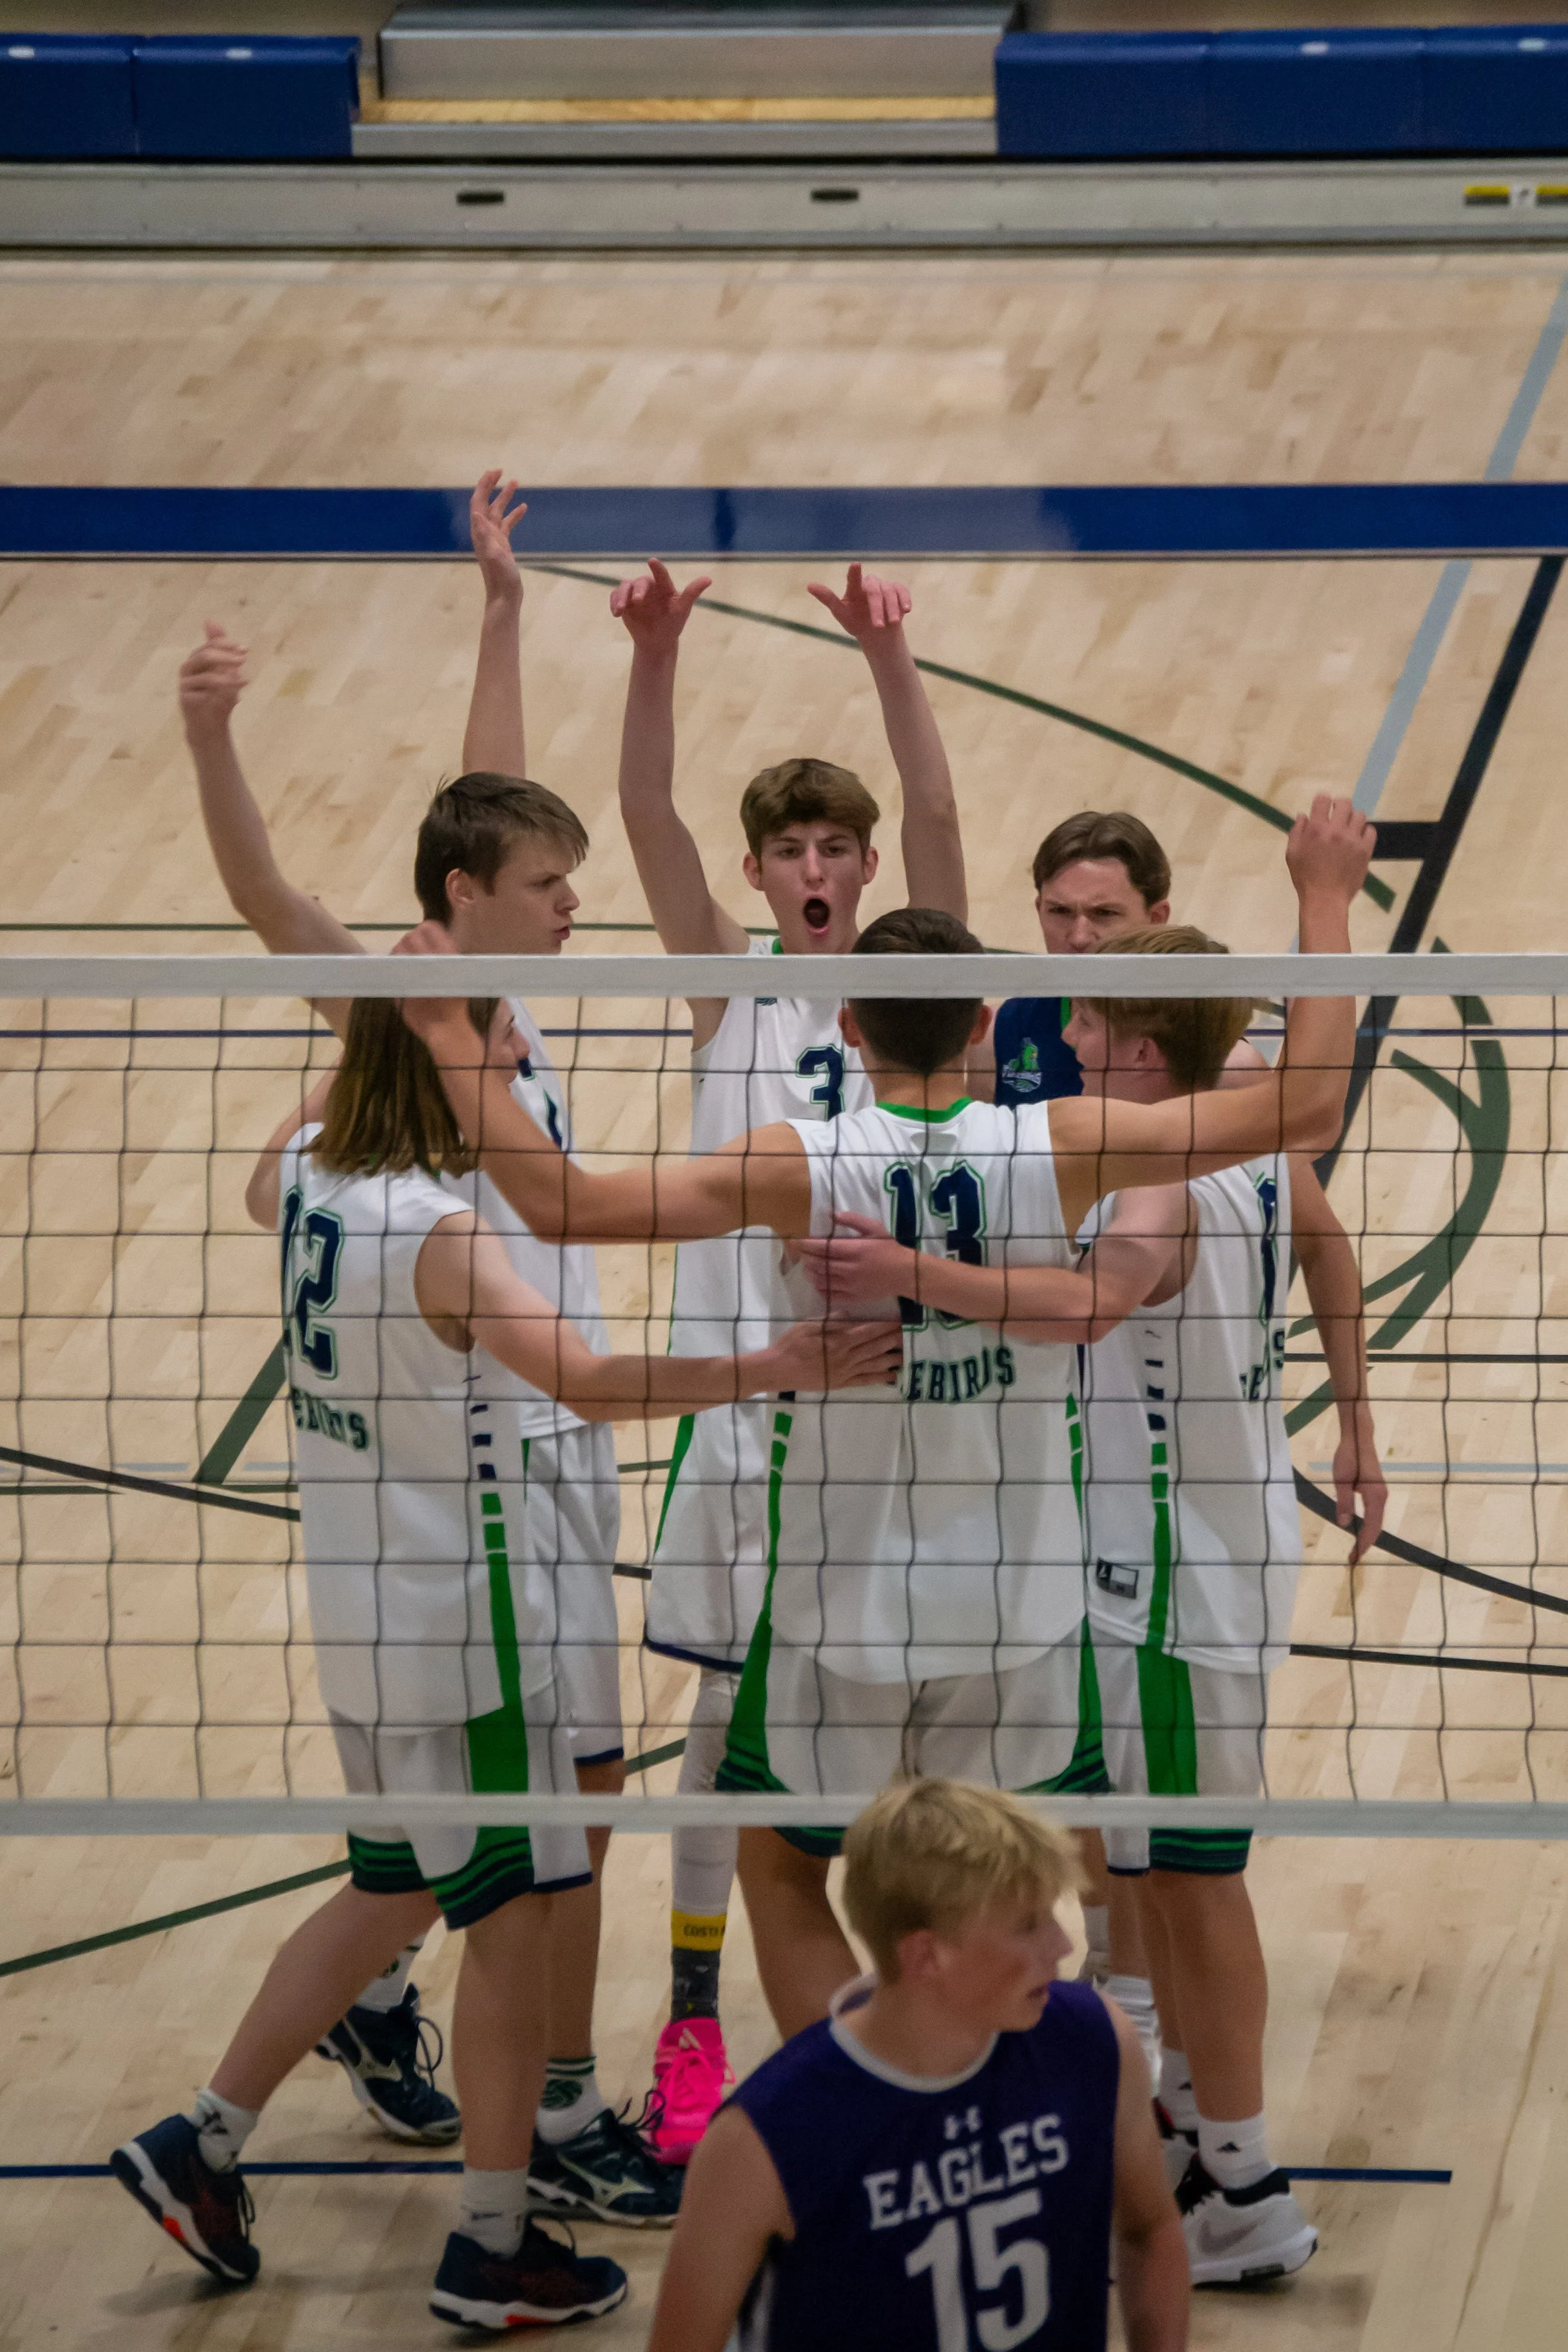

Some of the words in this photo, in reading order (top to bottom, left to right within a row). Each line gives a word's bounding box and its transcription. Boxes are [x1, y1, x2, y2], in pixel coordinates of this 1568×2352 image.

[795, 1043, 846, 1122] 3
[281, 1184, 344, 1380] 12
[884, 1160, 988, 1331] 13
[862, 2112, 1069, 2230] EAGLES
[905, 2188, 1050, 2352] 15
